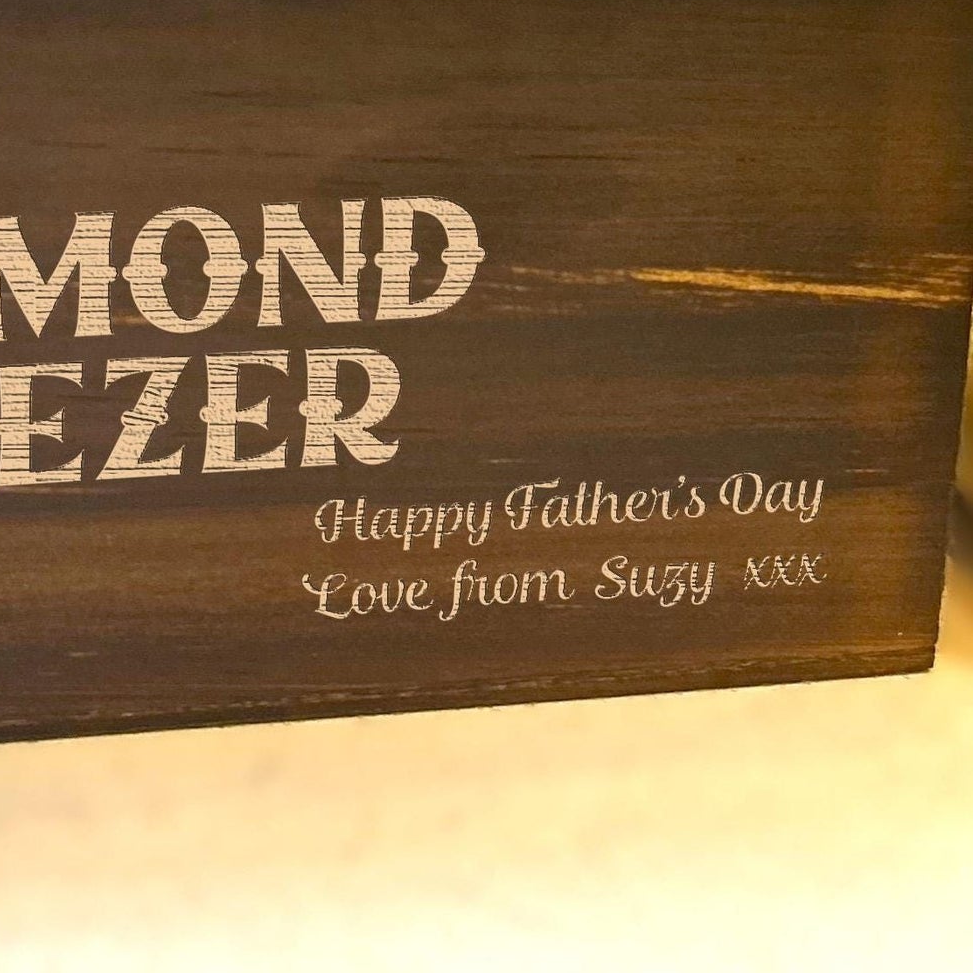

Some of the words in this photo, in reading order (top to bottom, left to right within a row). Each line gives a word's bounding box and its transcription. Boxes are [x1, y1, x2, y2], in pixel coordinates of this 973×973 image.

[314, 494, 493, 552] Happy
[504, 475, 707, 531] Father's
[719, 471, 825, 523] Day
[301, 572, 434, 620] Love
[438, 559, 576, 622] from
[594, 555, 717, 608] Suzy
